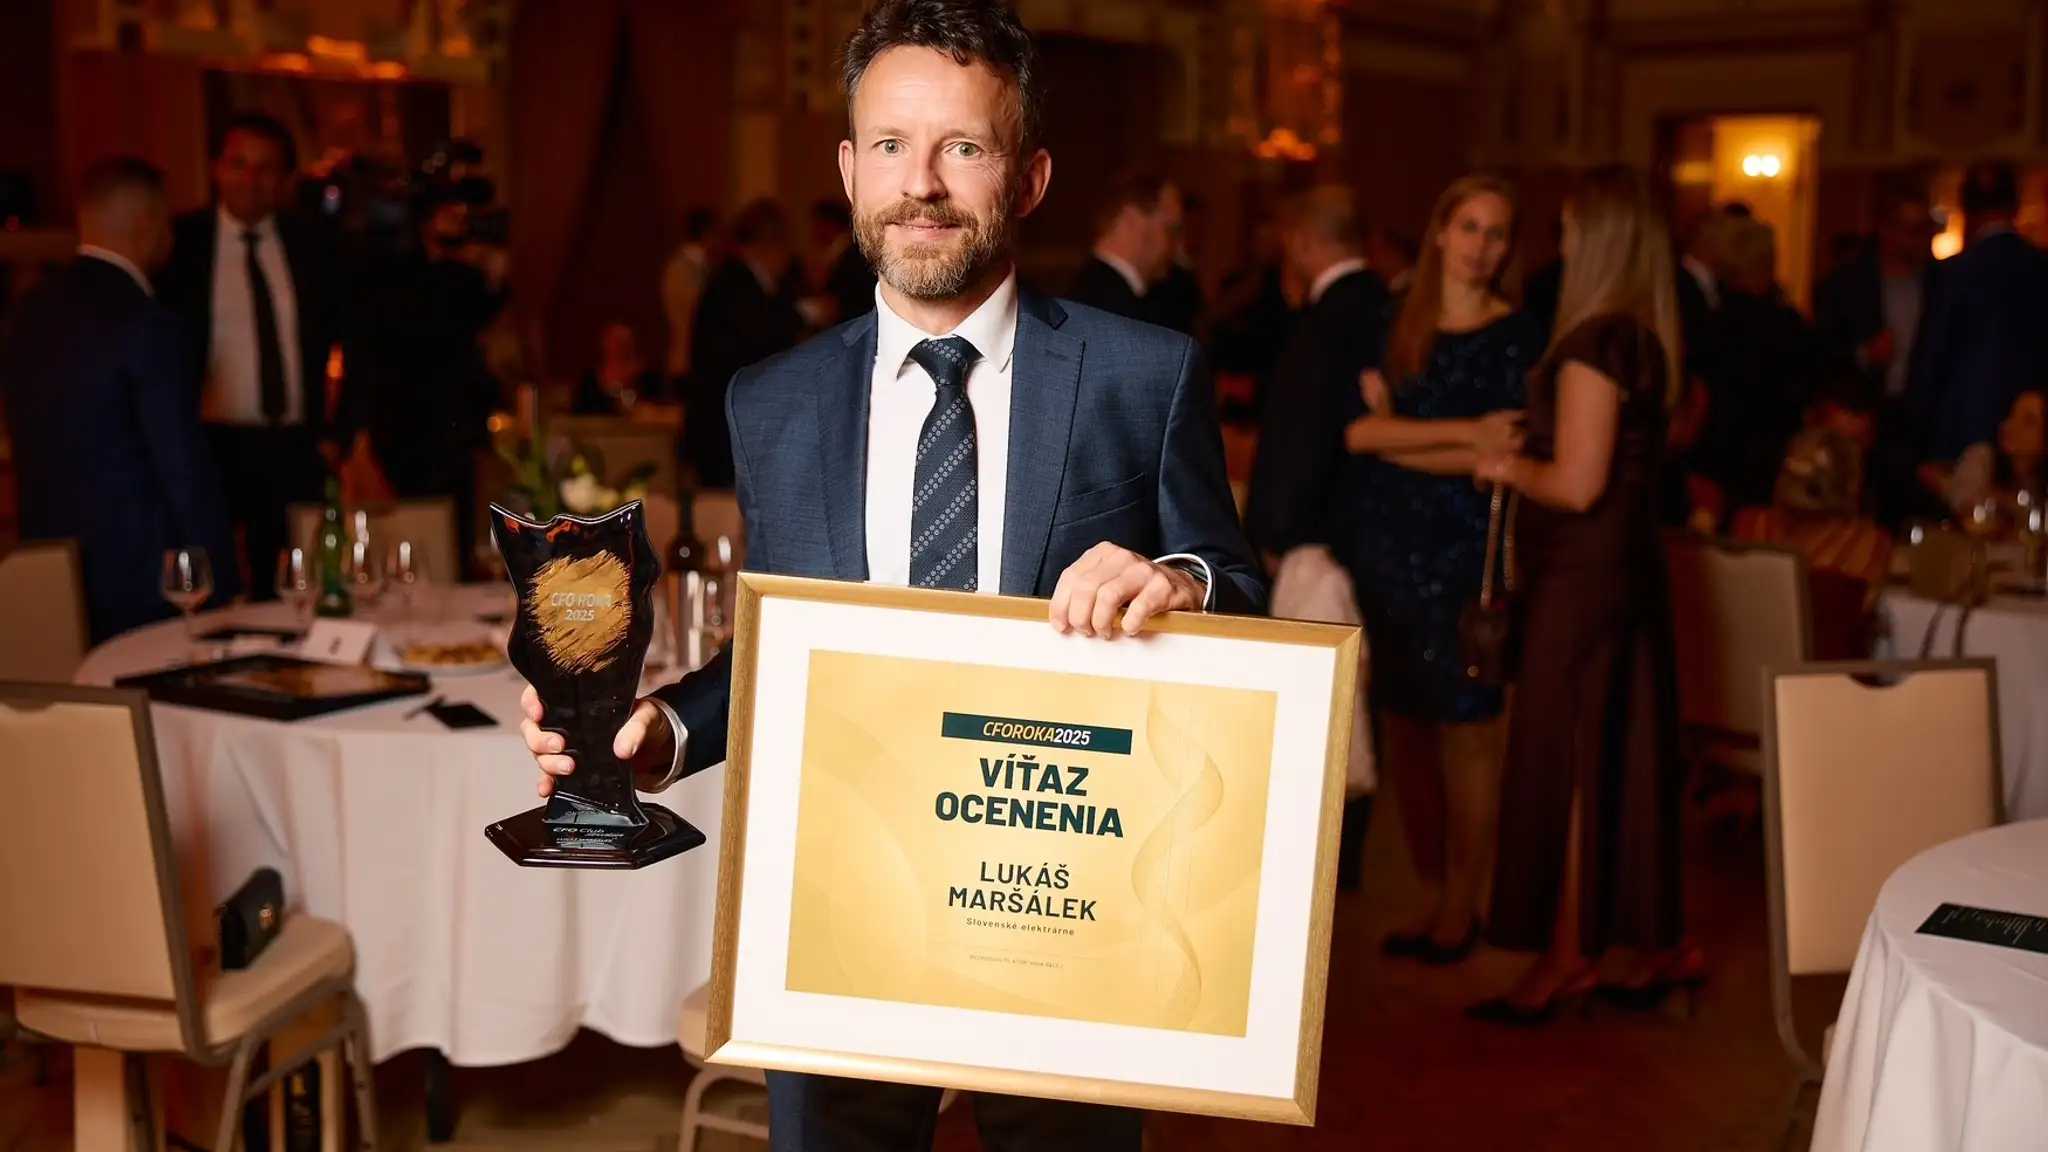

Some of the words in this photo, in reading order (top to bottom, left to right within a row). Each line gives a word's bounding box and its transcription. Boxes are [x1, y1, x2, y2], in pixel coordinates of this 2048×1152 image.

[551, 592, 576, 607] CFO
[565, 609, 595, 621] 2025
[979, 753, 1089, 797] VÍŤAZ
[935, 791, 1124, 838] OCENENIA
[980, 861, 1070, 890] LUKÁŠ
[948, 886, 1097, 921] MARŠÁLEK
[966, 917, 1017, 930] Slovenské
[1021, 923, 1075, 936] elektrárne
